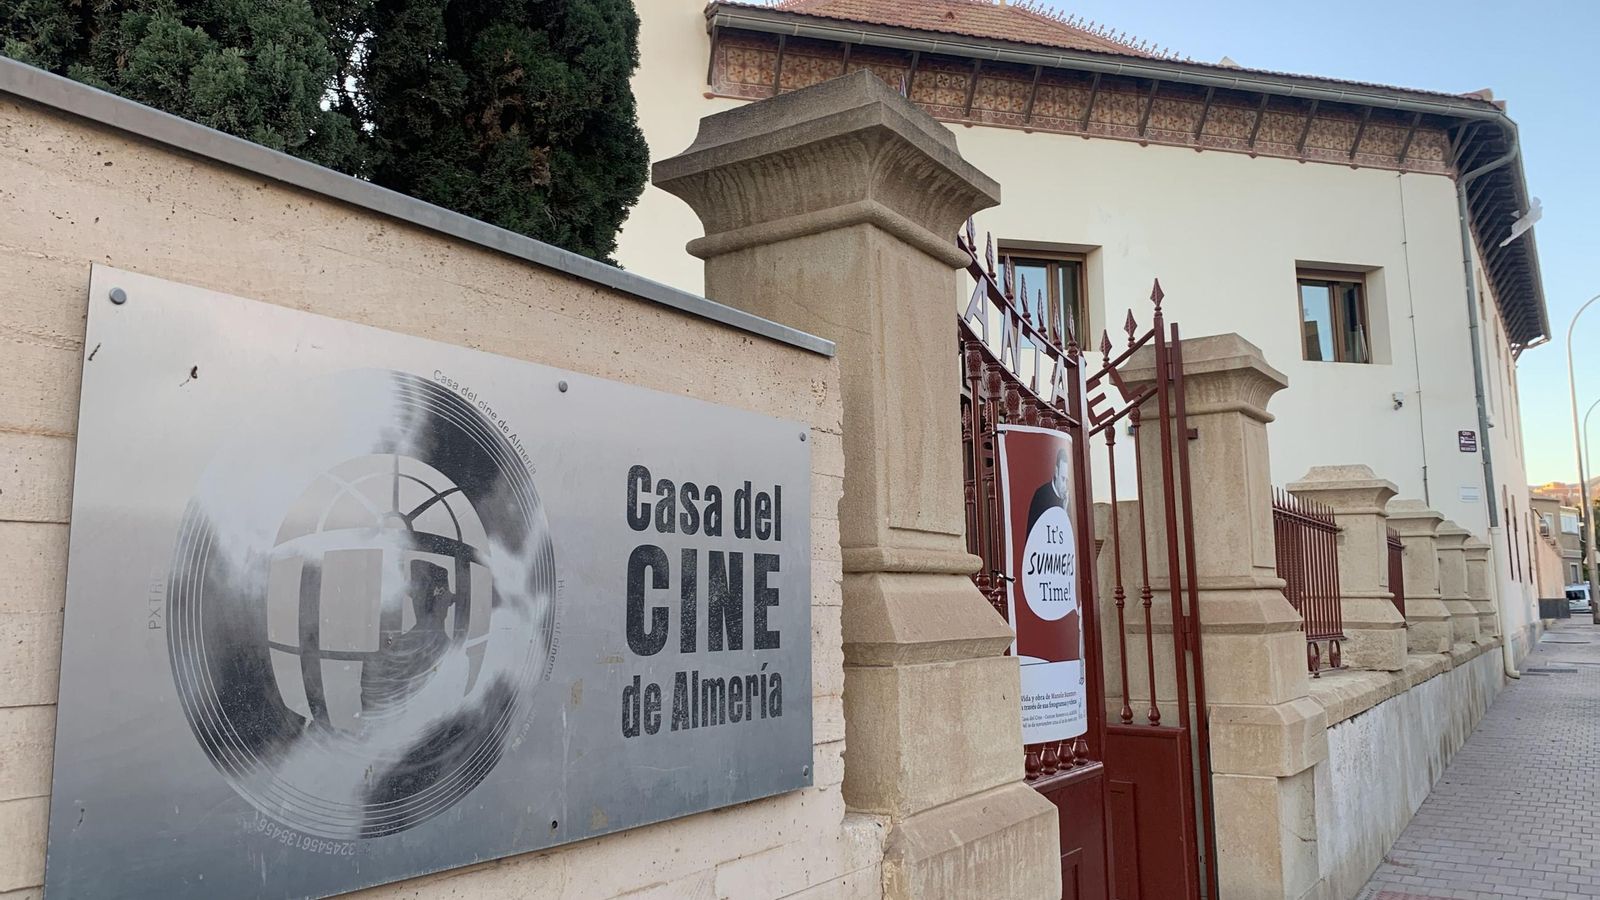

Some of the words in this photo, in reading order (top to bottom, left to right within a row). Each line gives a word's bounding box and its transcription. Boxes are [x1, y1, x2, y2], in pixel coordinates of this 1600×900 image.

[433, 369, 459, 391] Casa
[461, 387, 478, 402] del
[477, 401, 498, 419] cine
[497, 419, 511, 434] de
[626, 464, 723, 537] Casa
[734, 480, 782, 541] del
[1046, 525, 1063, 545] It's
[626, 544, 781, 657] CINE
[1039, 582, 1072, 602] Time!
[622, 674, 663, 738] de
[671, 662, 783, 732] Almería
